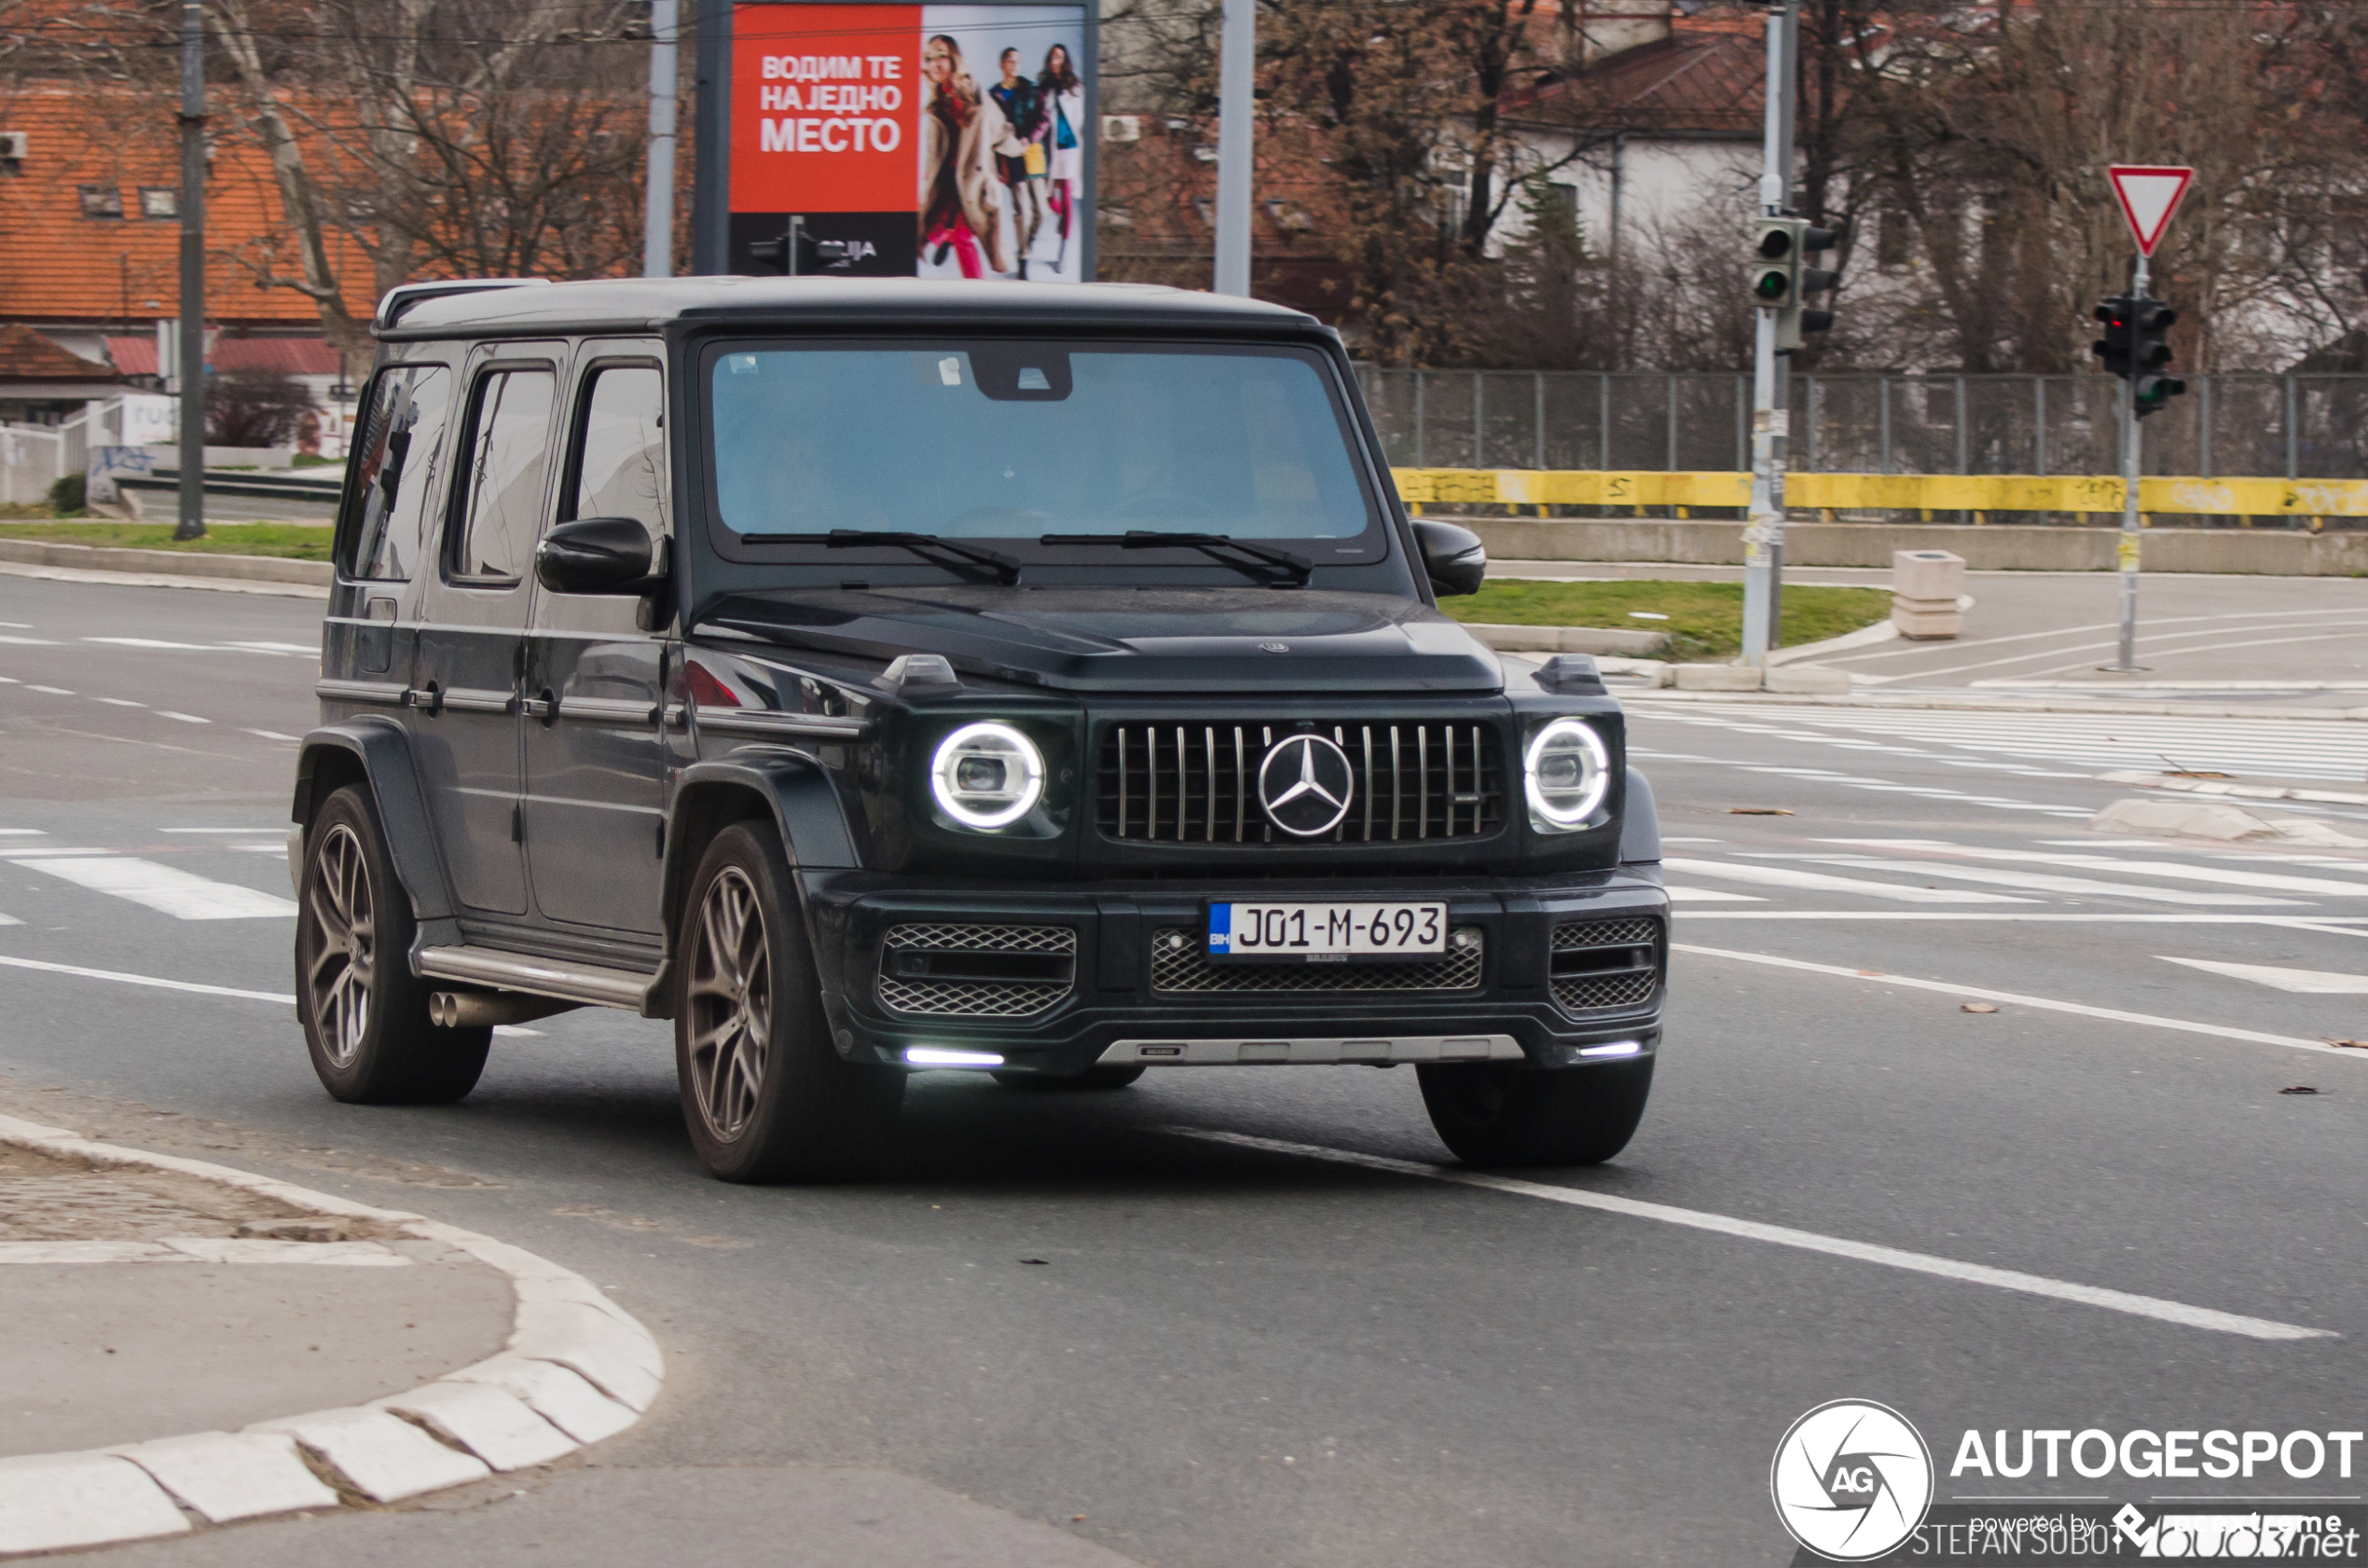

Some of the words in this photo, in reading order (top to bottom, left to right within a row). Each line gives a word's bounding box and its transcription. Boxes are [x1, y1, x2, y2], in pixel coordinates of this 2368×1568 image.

[762, 56, 861, 83] ВОДИМ
[866, 56, 902, 79] ТЕ
[760, 85, 803, 110] НА
[805, 85, 902, 115] ЈЕДНО
[761, 117, 902, 152] МЕСТО
[1239, 908, 1439, 946] J01-M-693
